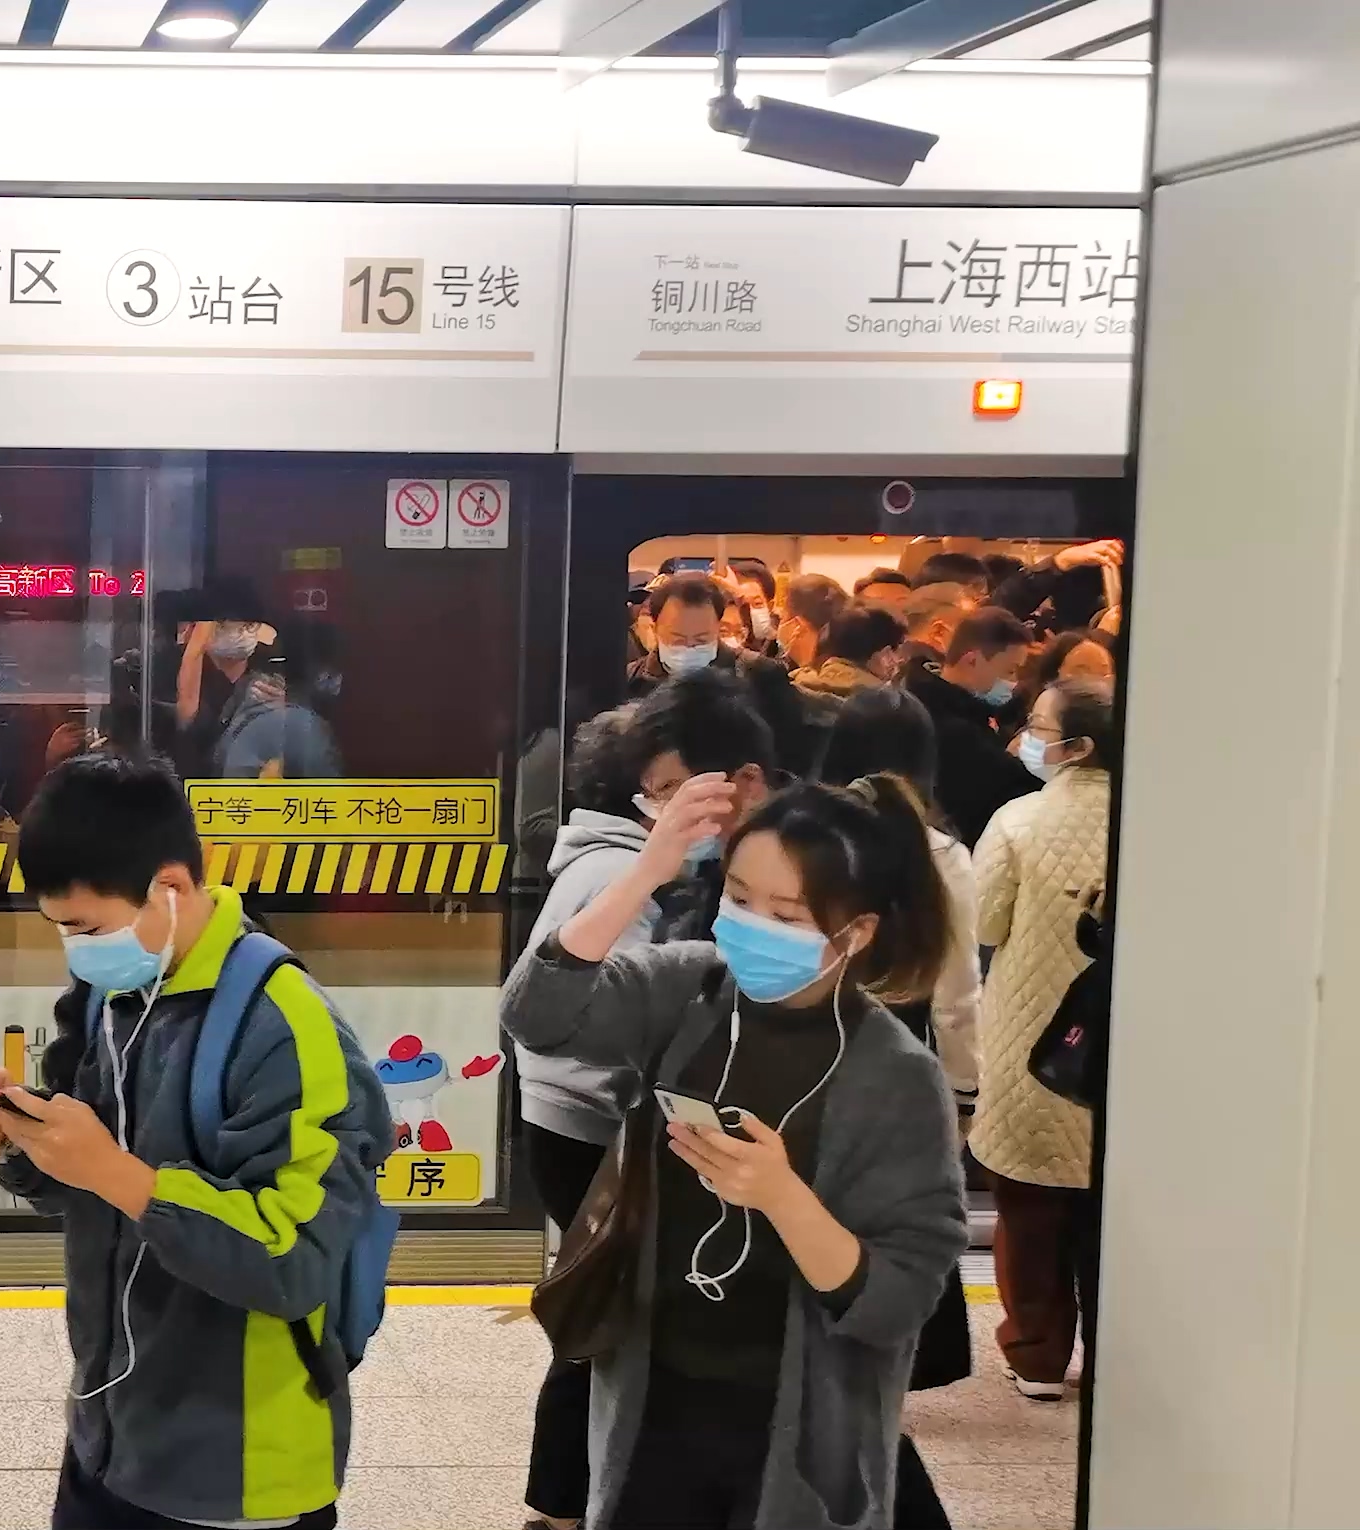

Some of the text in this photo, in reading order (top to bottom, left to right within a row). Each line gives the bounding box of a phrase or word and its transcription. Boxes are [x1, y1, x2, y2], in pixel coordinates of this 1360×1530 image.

[653, 254, 701, 270] 下一站
[868, 238, 1138, 308] 上海西站
[122, 260, 160, 318] 3
[188, 275, 283, 325] 站台
[349, 265, 414, 325] 15
[432, 264, 520, 308] 号线
[651, 279, 758, 314] 铜川路
[432, 313, 496, 330] Line 15
[647, 318, 761, 336] Tongchuan Road
[845, 313, 942, 338] Shanghai
[949, 315, 1001, 334] West
[1007, 315, 1087, 339] Railway
[89, 569, 121, 596] To
[196, 796, 488, 825] 宁等一列车 不抢一扇门
